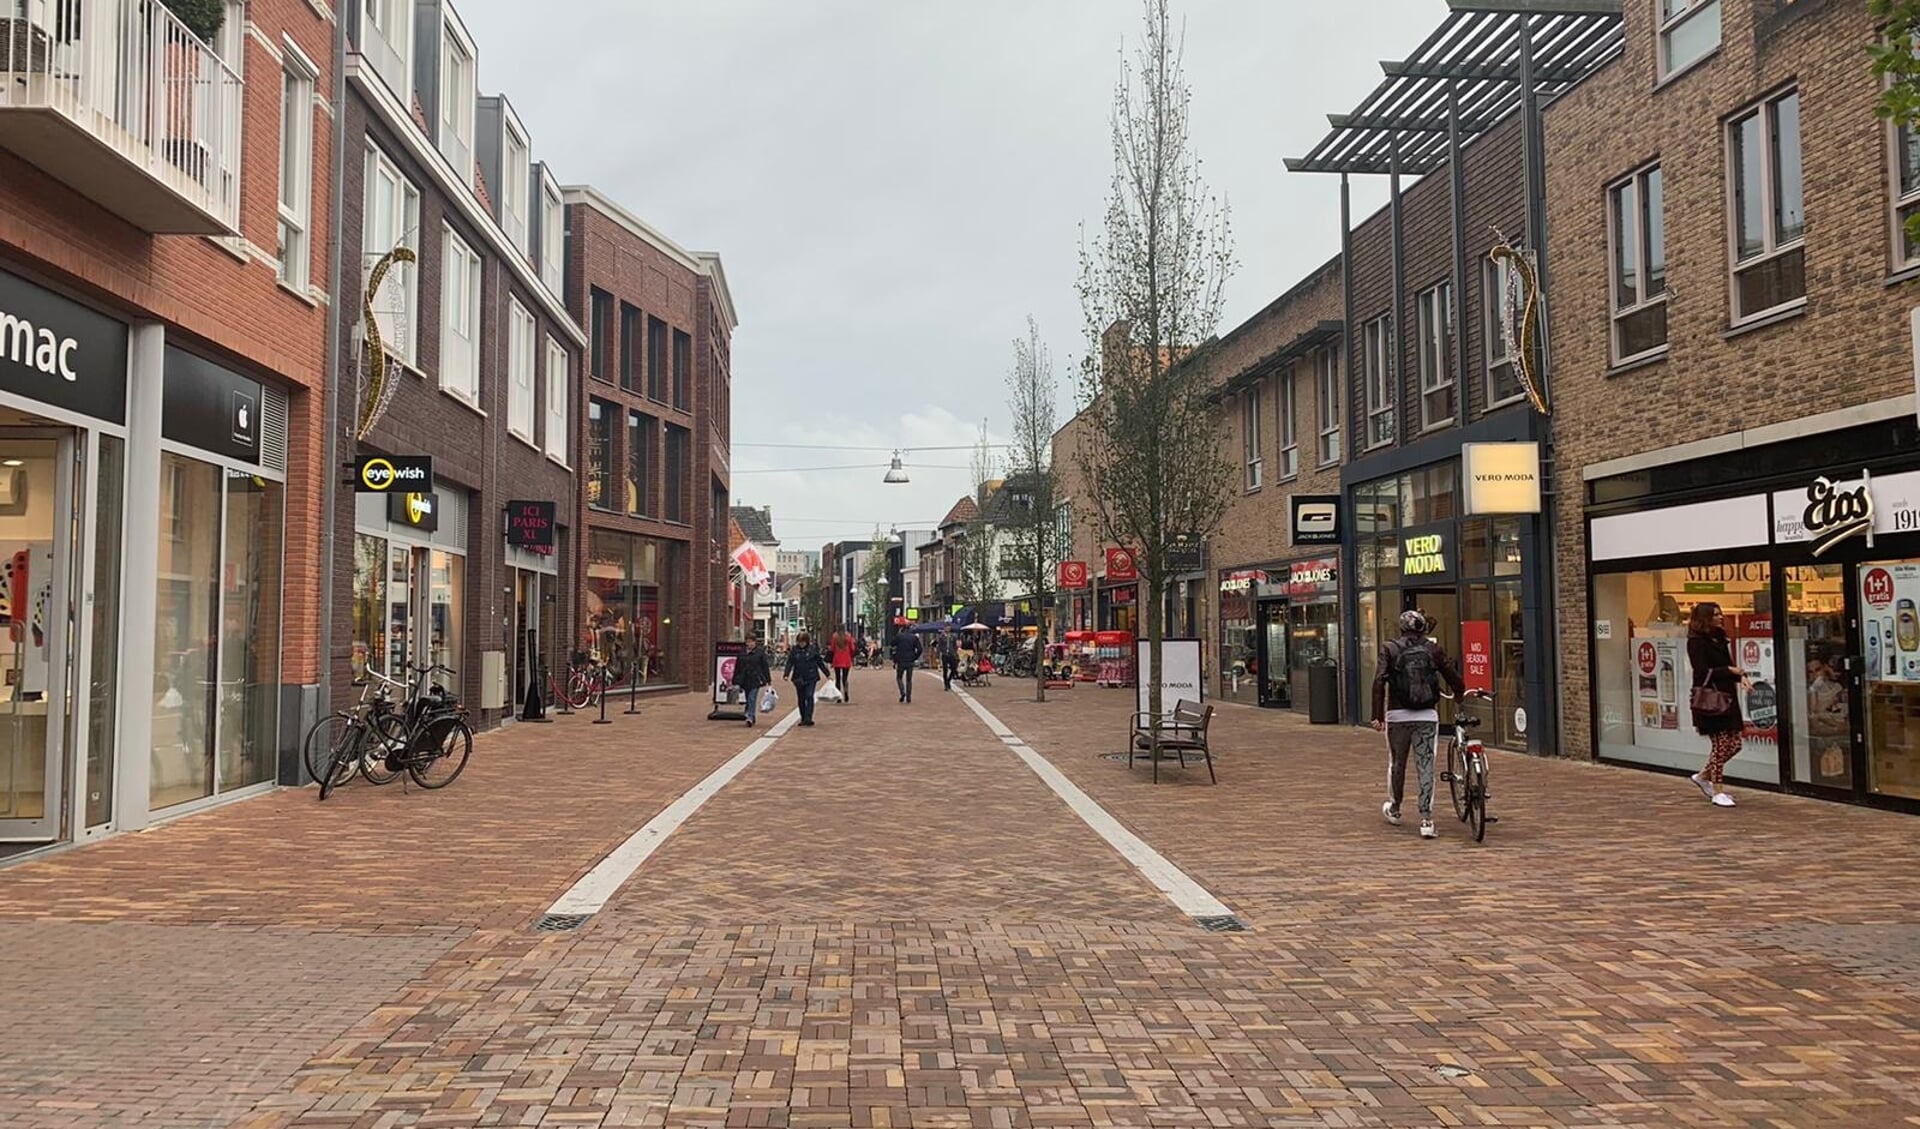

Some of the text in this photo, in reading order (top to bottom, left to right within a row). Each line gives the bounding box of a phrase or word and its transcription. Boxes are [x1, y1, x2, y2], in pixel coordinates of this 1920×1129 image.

[366, 466, 425, 482] eyewish
[1475, 474, 1502, 482] VERO
[1803, 477, 1871, 532] Etos
[523, 505, 540, 517] ICI
[512, 516, 548, 529] PARIS
[1893, 508, 1920, 531] 191
[523, 529, 537, 539] XL
[1405, 534, 1442, 556] VERO
[1404, 554, 1446, 575] MODA
[1867, 575, 1889, 593] 1+1
[1868, 592, 1890, 602] gratis
[1470, 642, 1482, 652] MID
[1466, 653, 1488, 664] SEASON
[1470, 665, 1485, 675] SALE
